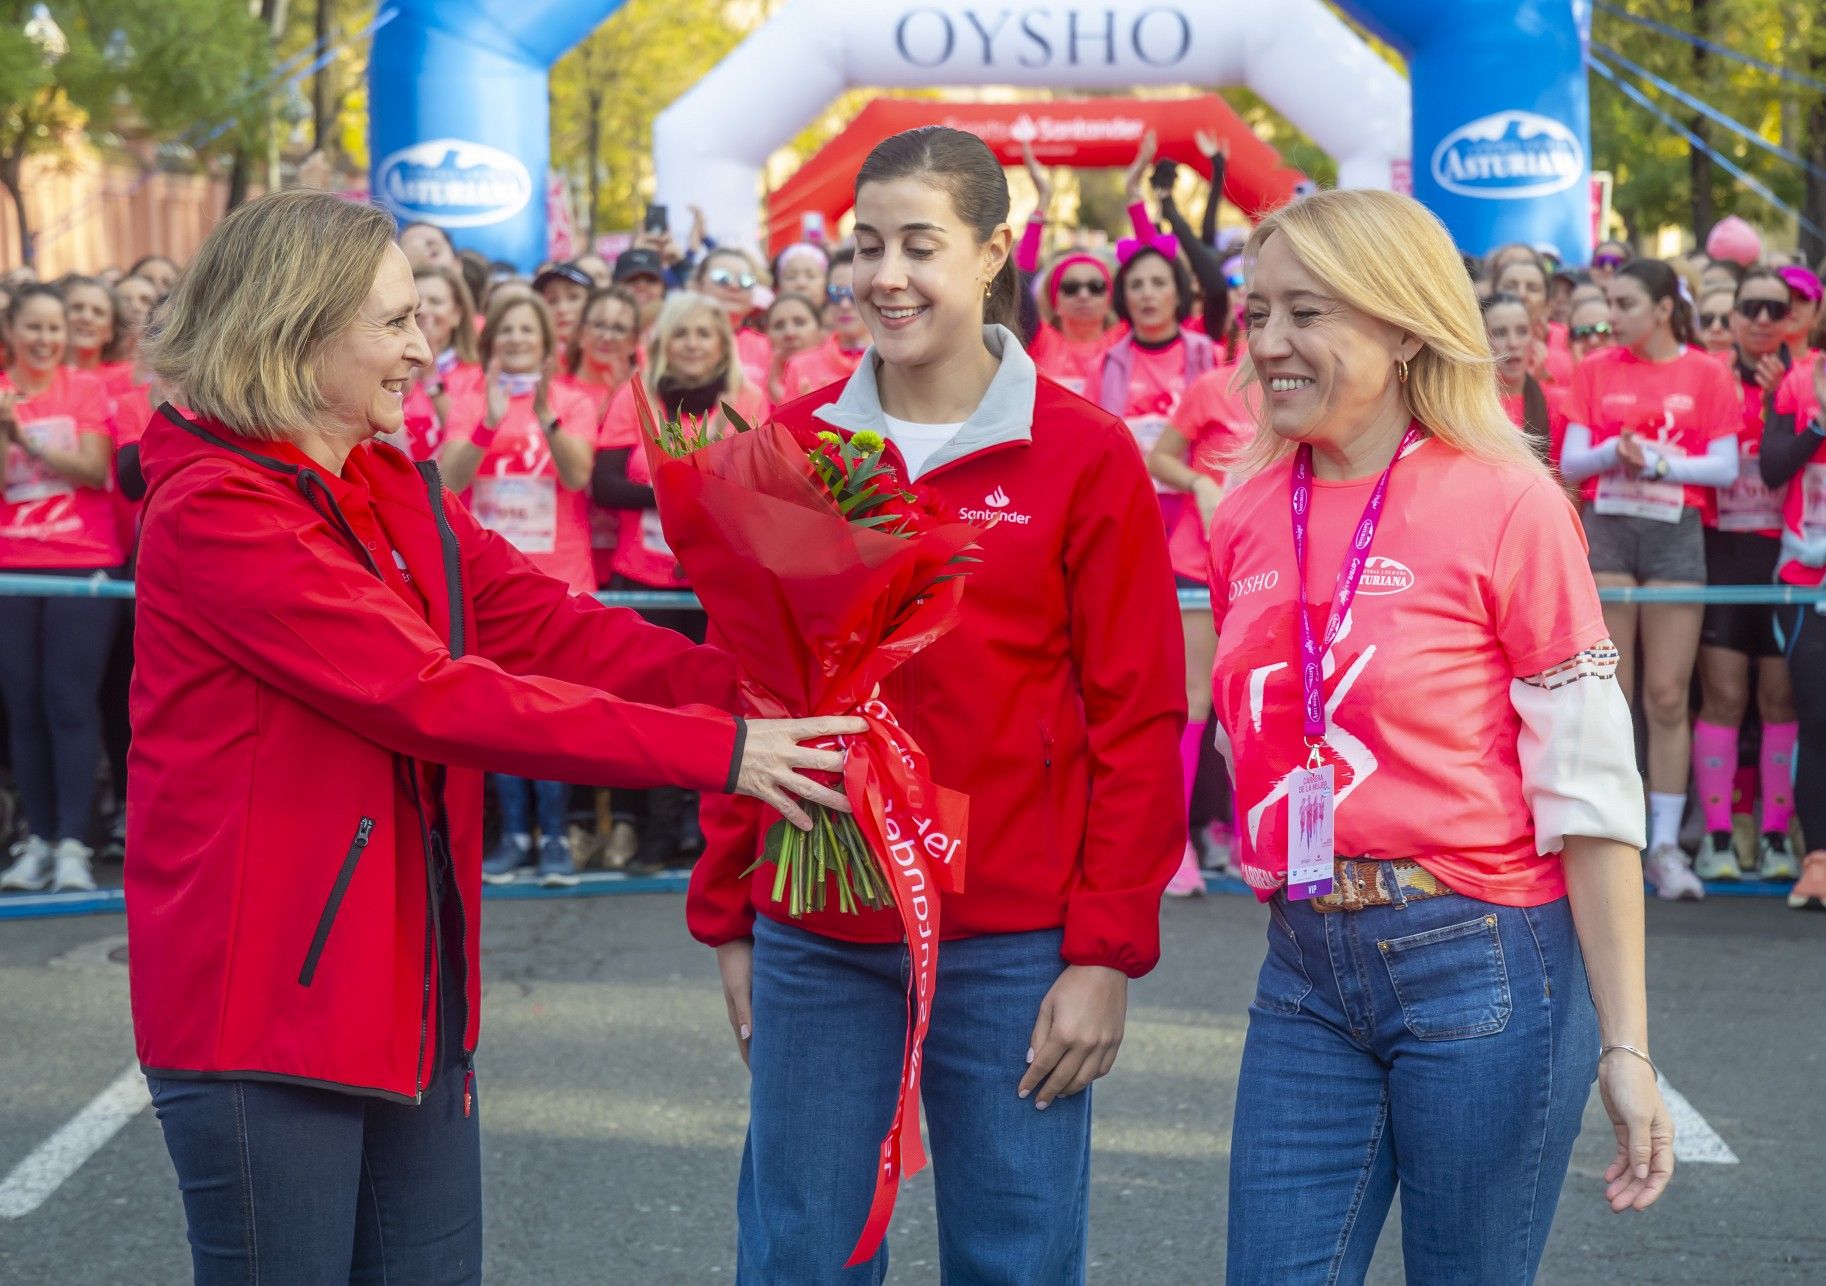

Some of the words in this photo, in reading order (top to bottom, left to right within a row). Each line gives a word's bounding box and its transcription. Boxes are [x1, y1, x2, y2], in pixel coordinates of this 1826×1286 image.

[895, 8, 1192, 67] OYSHO
[1359, 574, 1407, 587] TURIANA
[1308, 884, 1317, 895] VIP
